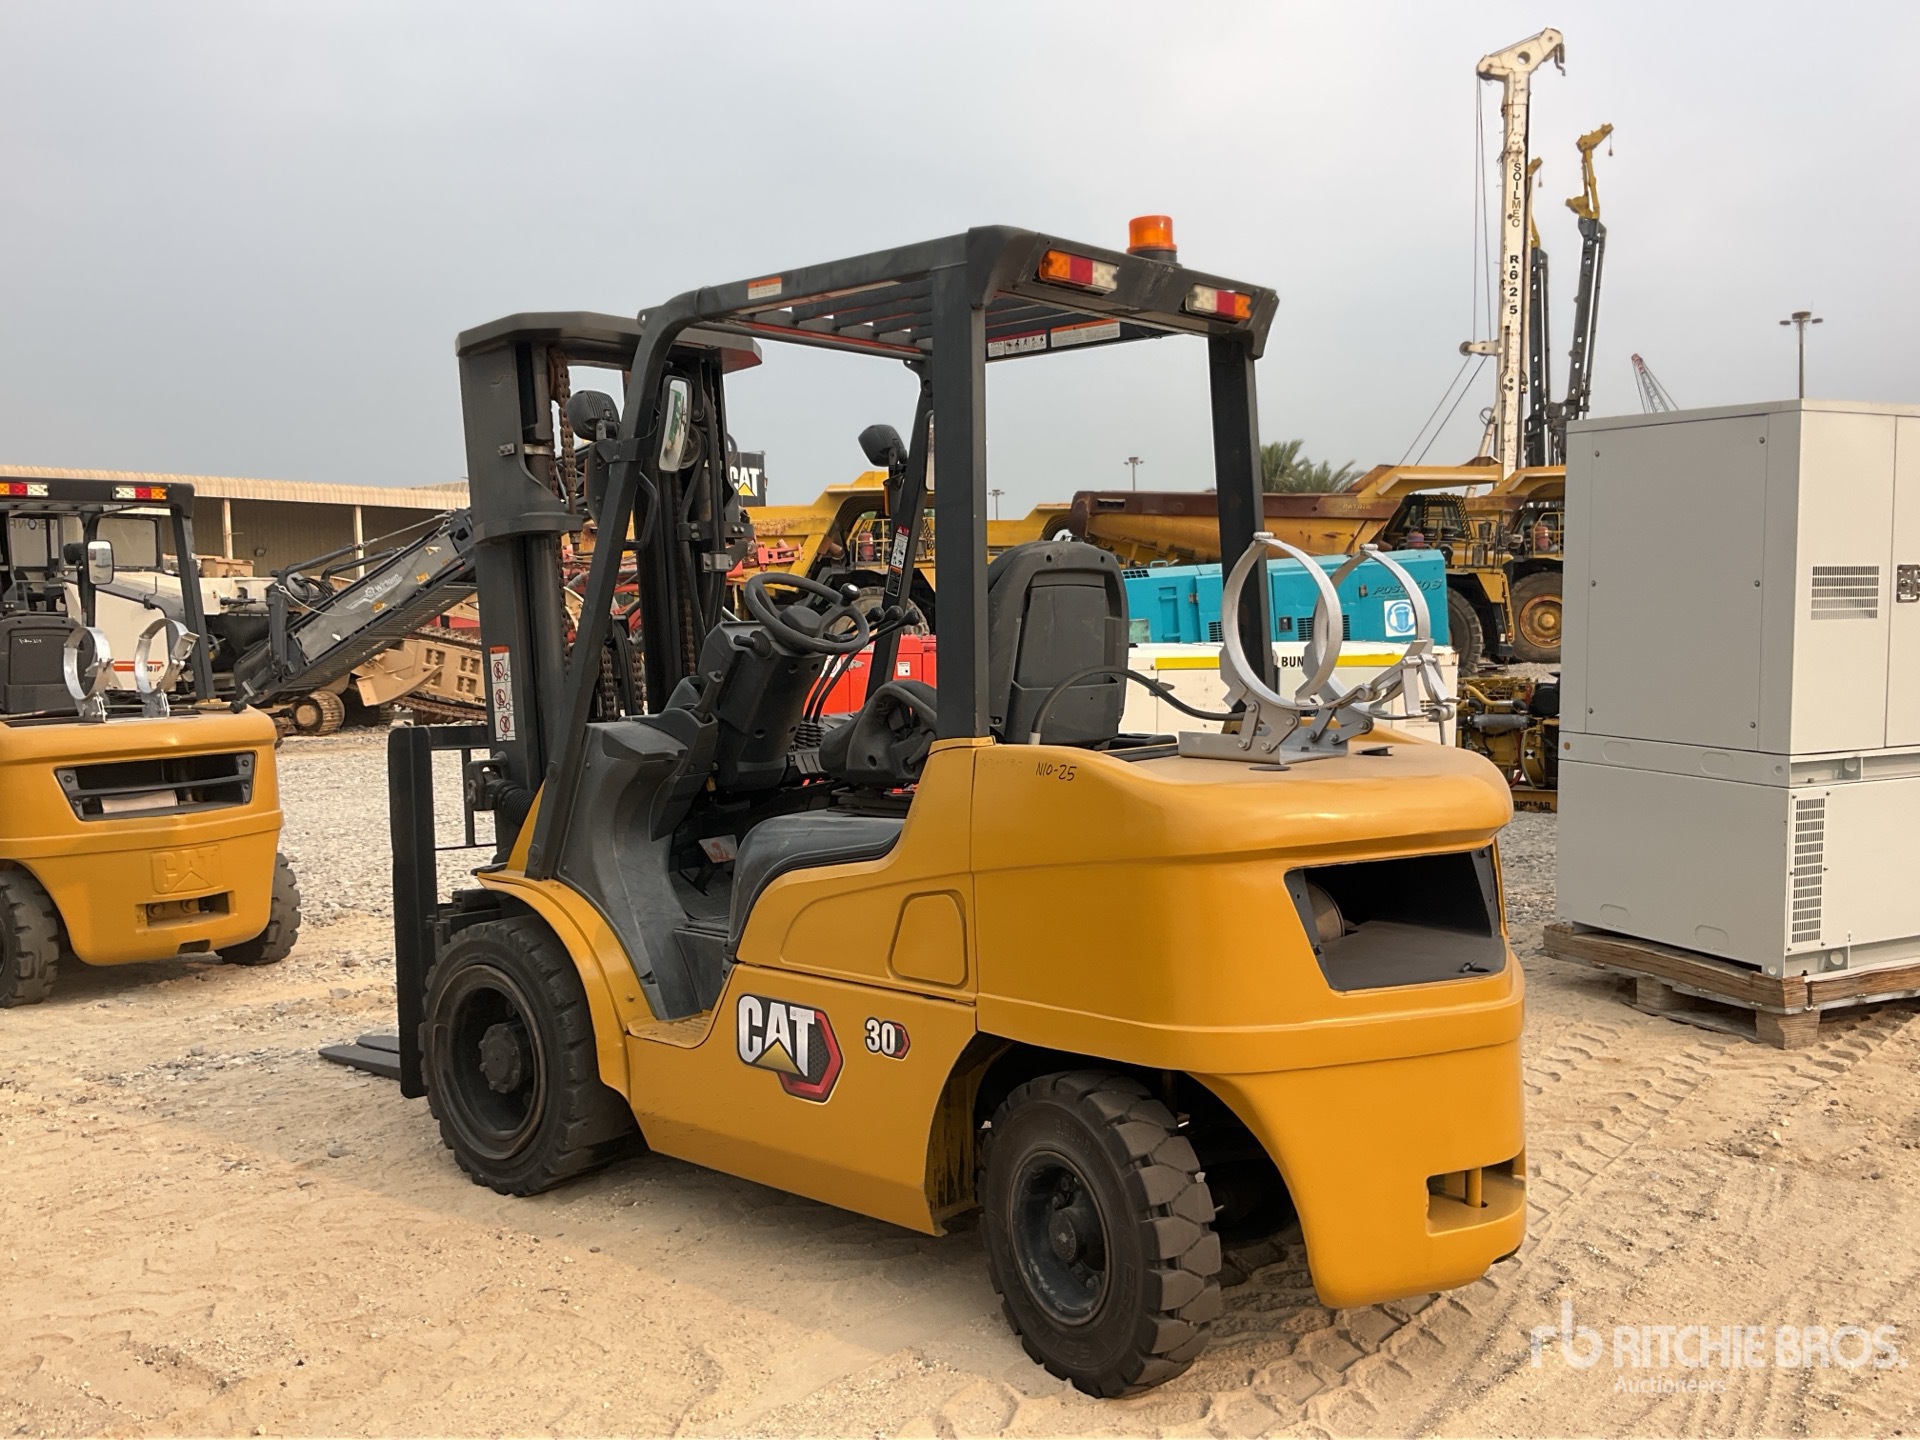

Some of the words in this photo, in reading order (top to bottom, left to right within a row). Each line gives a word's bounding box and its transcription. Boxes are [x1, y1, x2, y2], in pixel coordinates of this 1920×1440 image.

[1511, 162, 1522, 228] SOILMEC
[729, 466, 760, 497] CAT
[151, 844, 221, 895] CAT
[737, 995, 815, 1077] CAT
[865, 1018, 896, 1055] 30
